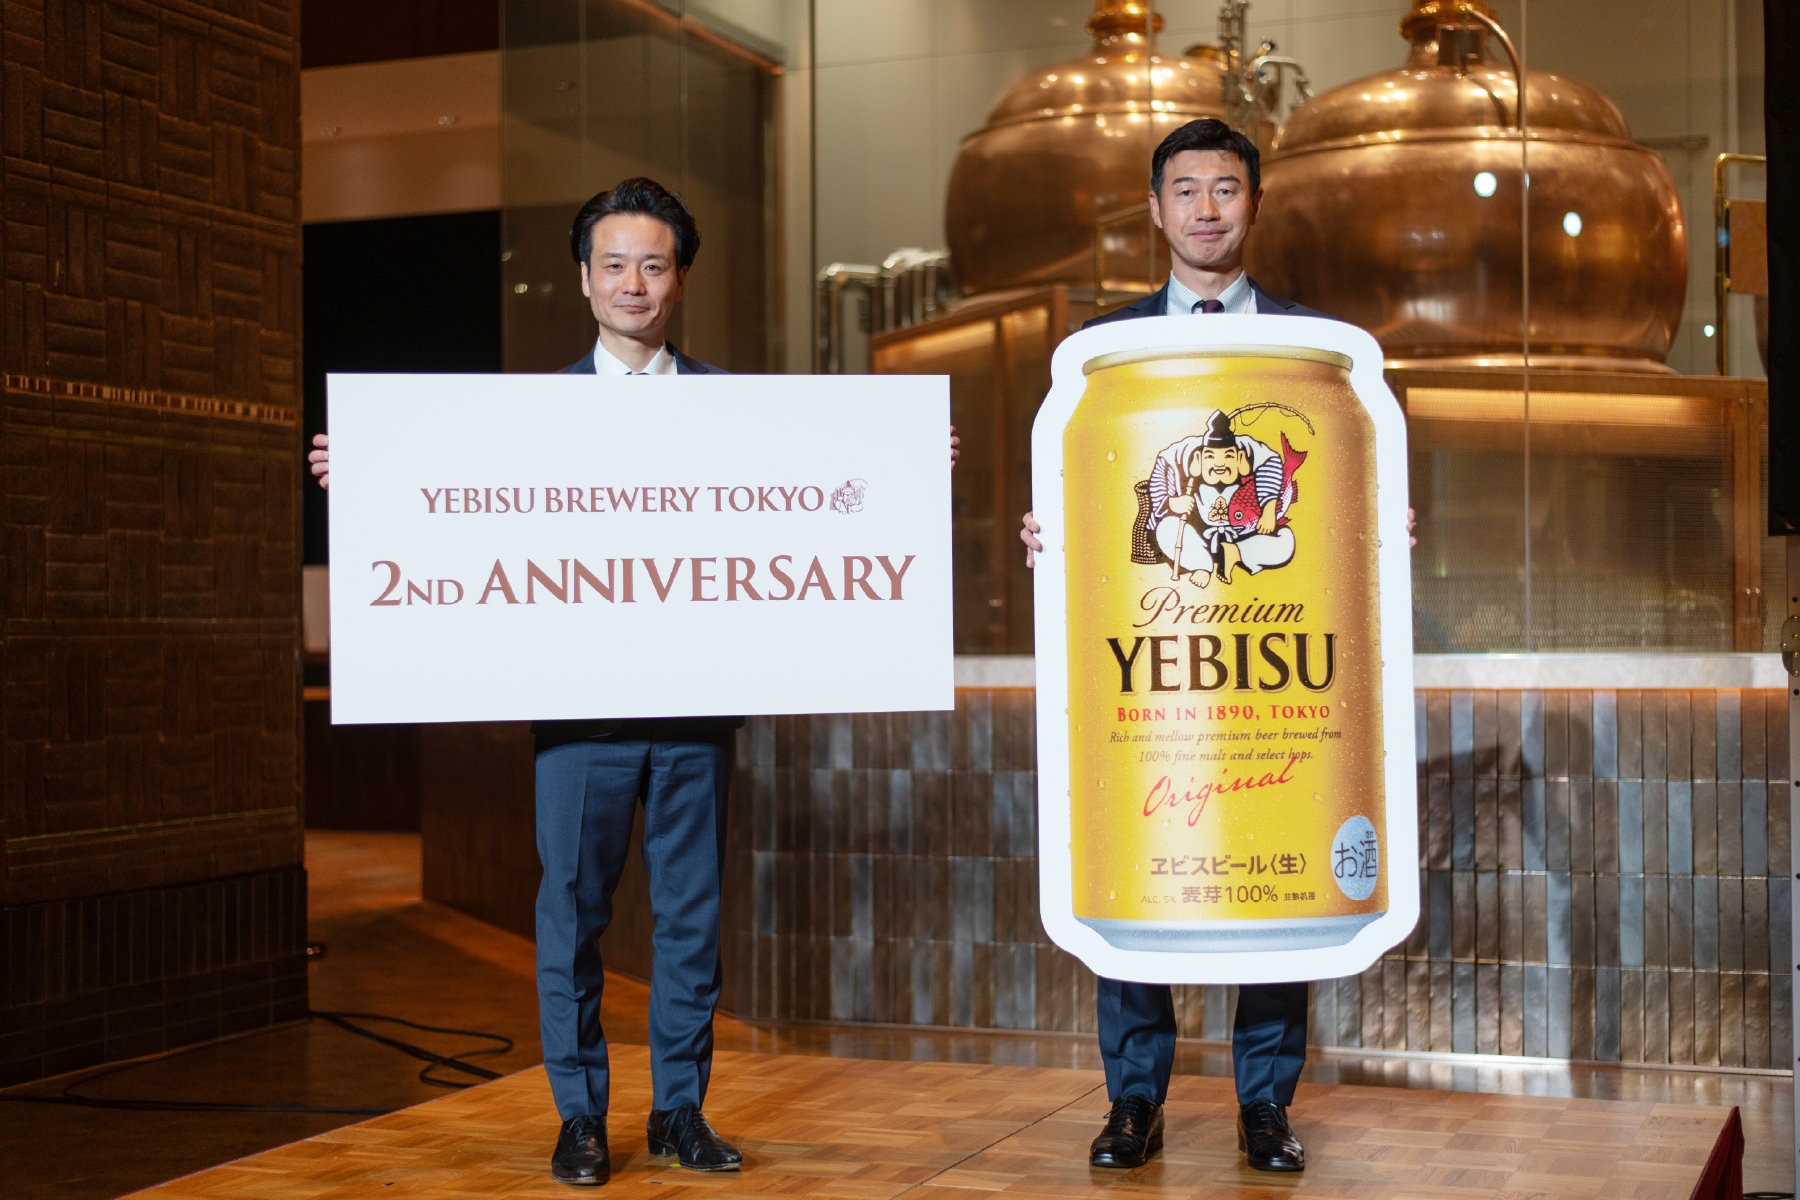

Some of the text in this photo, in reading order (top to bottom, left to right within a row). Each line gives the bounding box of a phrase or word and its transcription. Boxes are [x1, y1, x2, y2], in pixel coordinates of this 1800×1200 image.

[420, 484, 824, 514] YEBISU BREWERY TOKYO
[370, 554, 917, 606] 2ND ANNIVERSARY
[1133, 587, 1305, 627] Premium
[1106, 633, 1337, 695] YEBISU
[1117, 704, 1331, 722] BORN IN 1890, TOKYO
[1109, 728, 1342, 745] Rich and mellow premium beer brewed from
[1139, 749, 1314, 765] 100% fine malt and select hops.
[1143, 756, 1297, 827] Original
[1334, 840, 1378, 879] お酒
[1181, 885, 1278, 904] 麦芽100%
